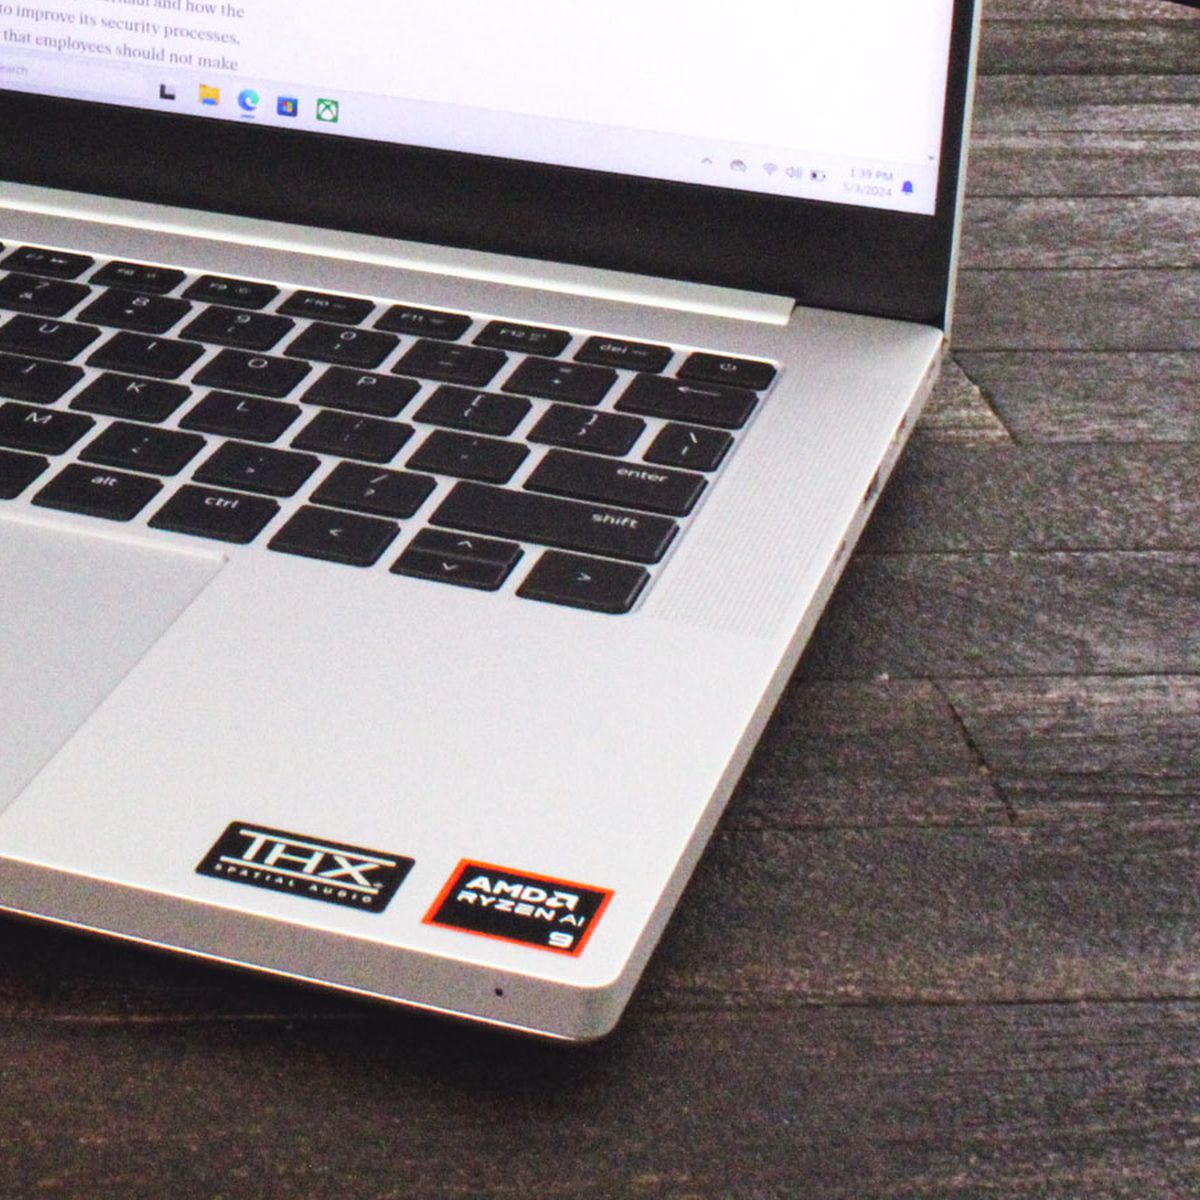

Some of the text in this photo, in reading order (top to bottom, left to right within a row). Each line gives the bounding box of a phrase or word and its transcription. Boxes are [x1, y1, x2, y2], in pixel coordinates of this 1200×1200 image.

[220, 3, 245, 19] the
[16, 5, 75, 24] improve
[79, 12, 97, 26] its
[100, 17, 159, 35] security
[163, 25, 240, 46] processes,
[3, 28, 31, 44] that
[34, 35, 112, 55] employees
[115, 43, 165, 62] should
[169, 52, 192, 65] not
[197, 55, 238, 72] make
[25, 412, 52, 424] M
[91, 475, 118, 487] alt
[617, 467, 668, 483] enter
[204, 496, 239, 509] ctrl
[592, 513, 638, 529] shift
[239, 829, 387, 892] THX
[213, 863, 374, 904] SPATIAL AUDIO
[466, 875, 547, 904] AMD
[457, 890, 585, 927] RYZEN AI
[548, 930, 574, 948] 9
